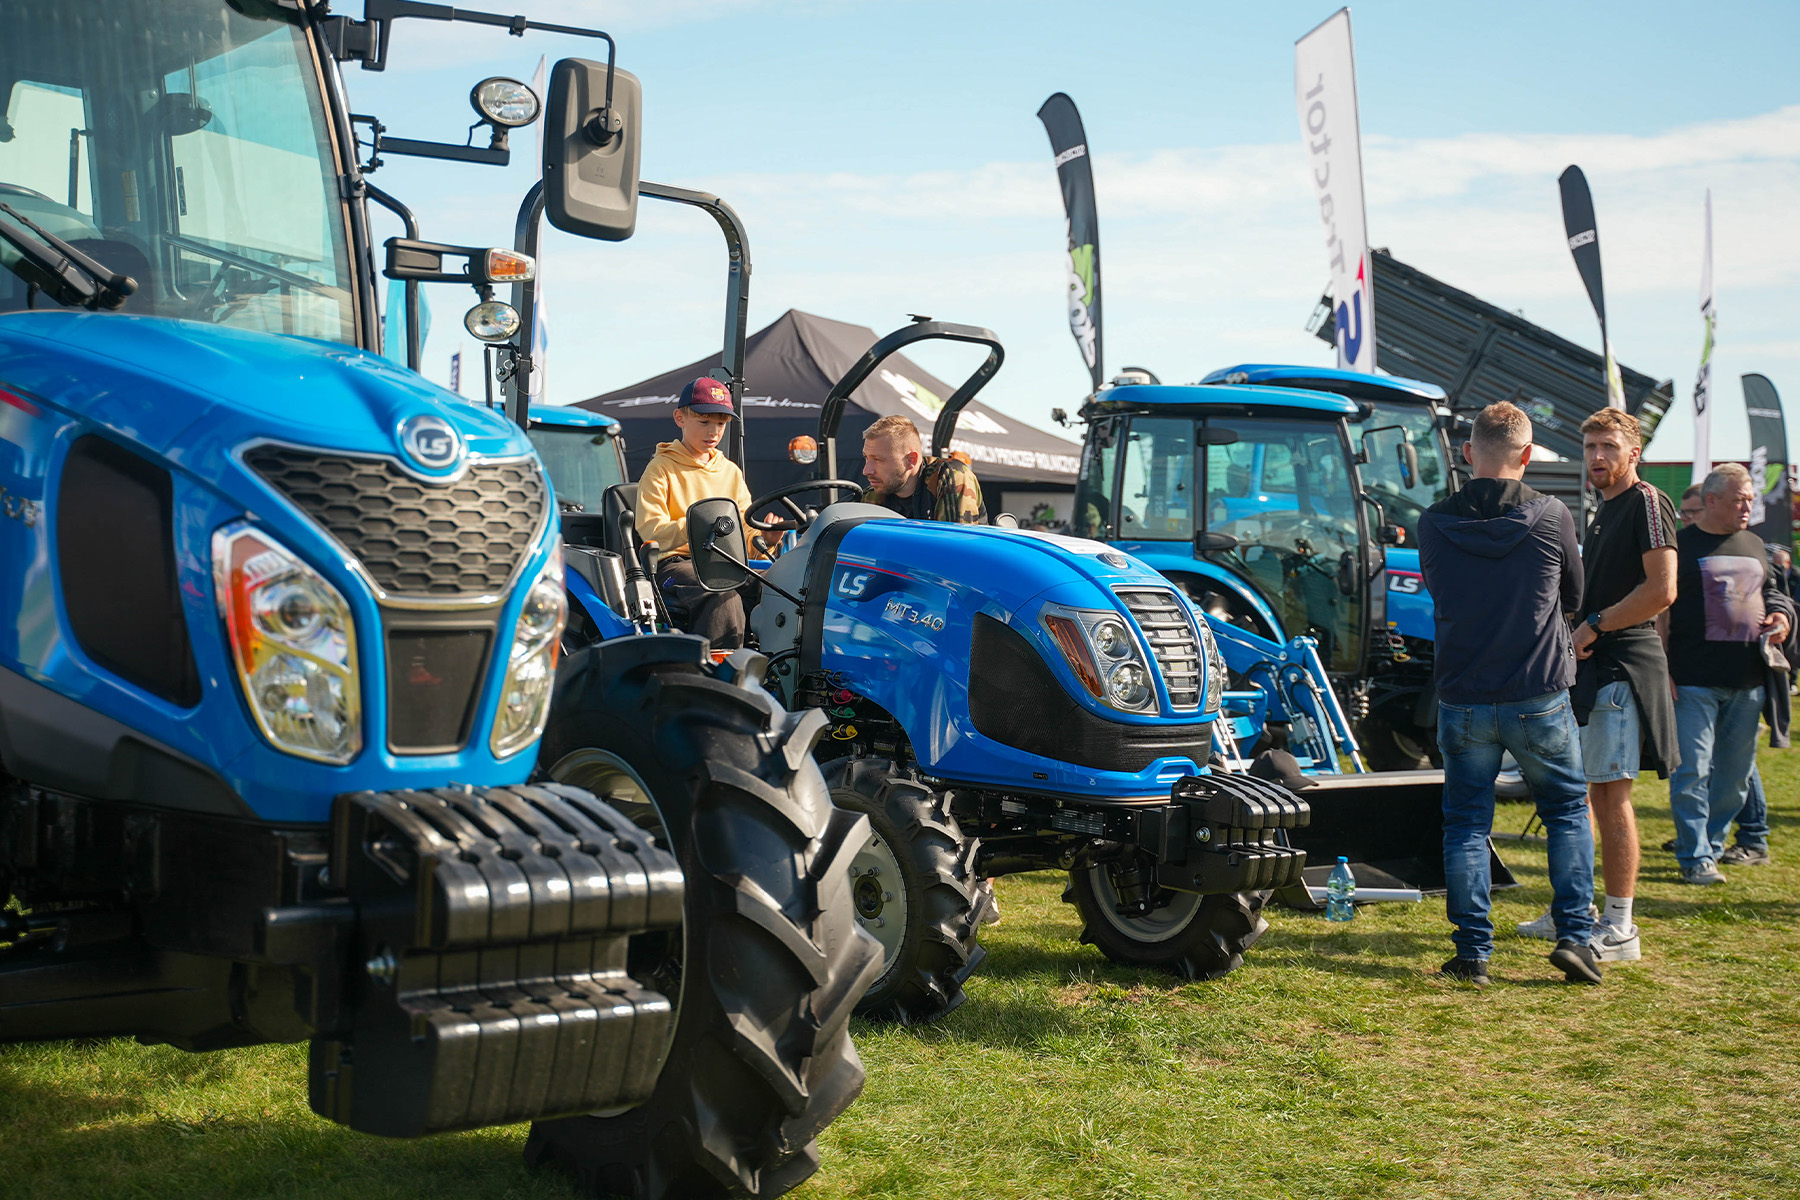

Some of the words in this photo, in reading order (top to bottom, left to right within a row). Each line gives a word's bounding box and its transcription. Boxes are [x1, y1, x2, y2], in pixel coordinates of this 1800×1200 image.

[419, 436, 451, 456] LS
[838, 571, 872, 596] LS
[1389, 575, 1420, 594] LS
